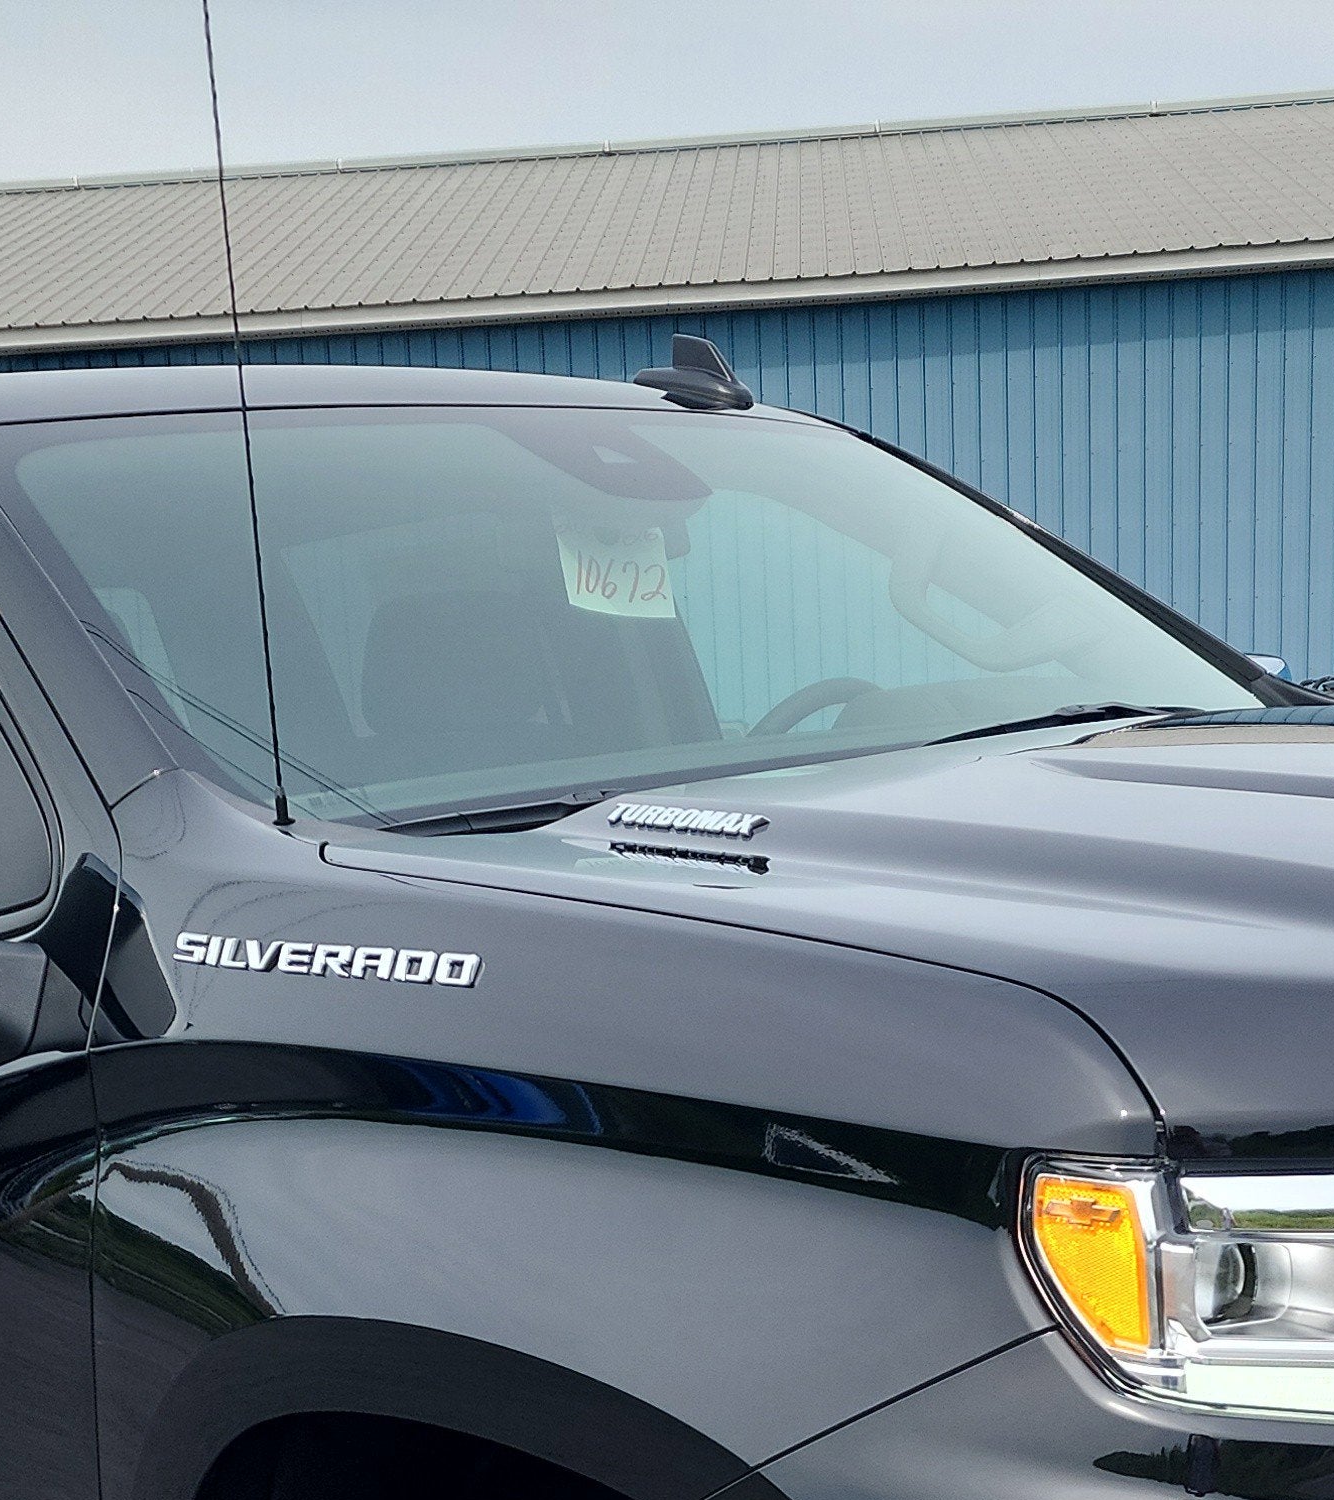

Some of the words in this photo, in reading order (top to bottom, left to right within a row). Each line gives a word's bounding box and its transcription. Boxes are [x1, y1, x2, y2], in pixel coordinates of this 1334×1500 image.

[576, 549, 667, 603] 10672
[607, 802, 771, 841] TURBOMAX
[172, 931, 483, 988] SILVERADO
